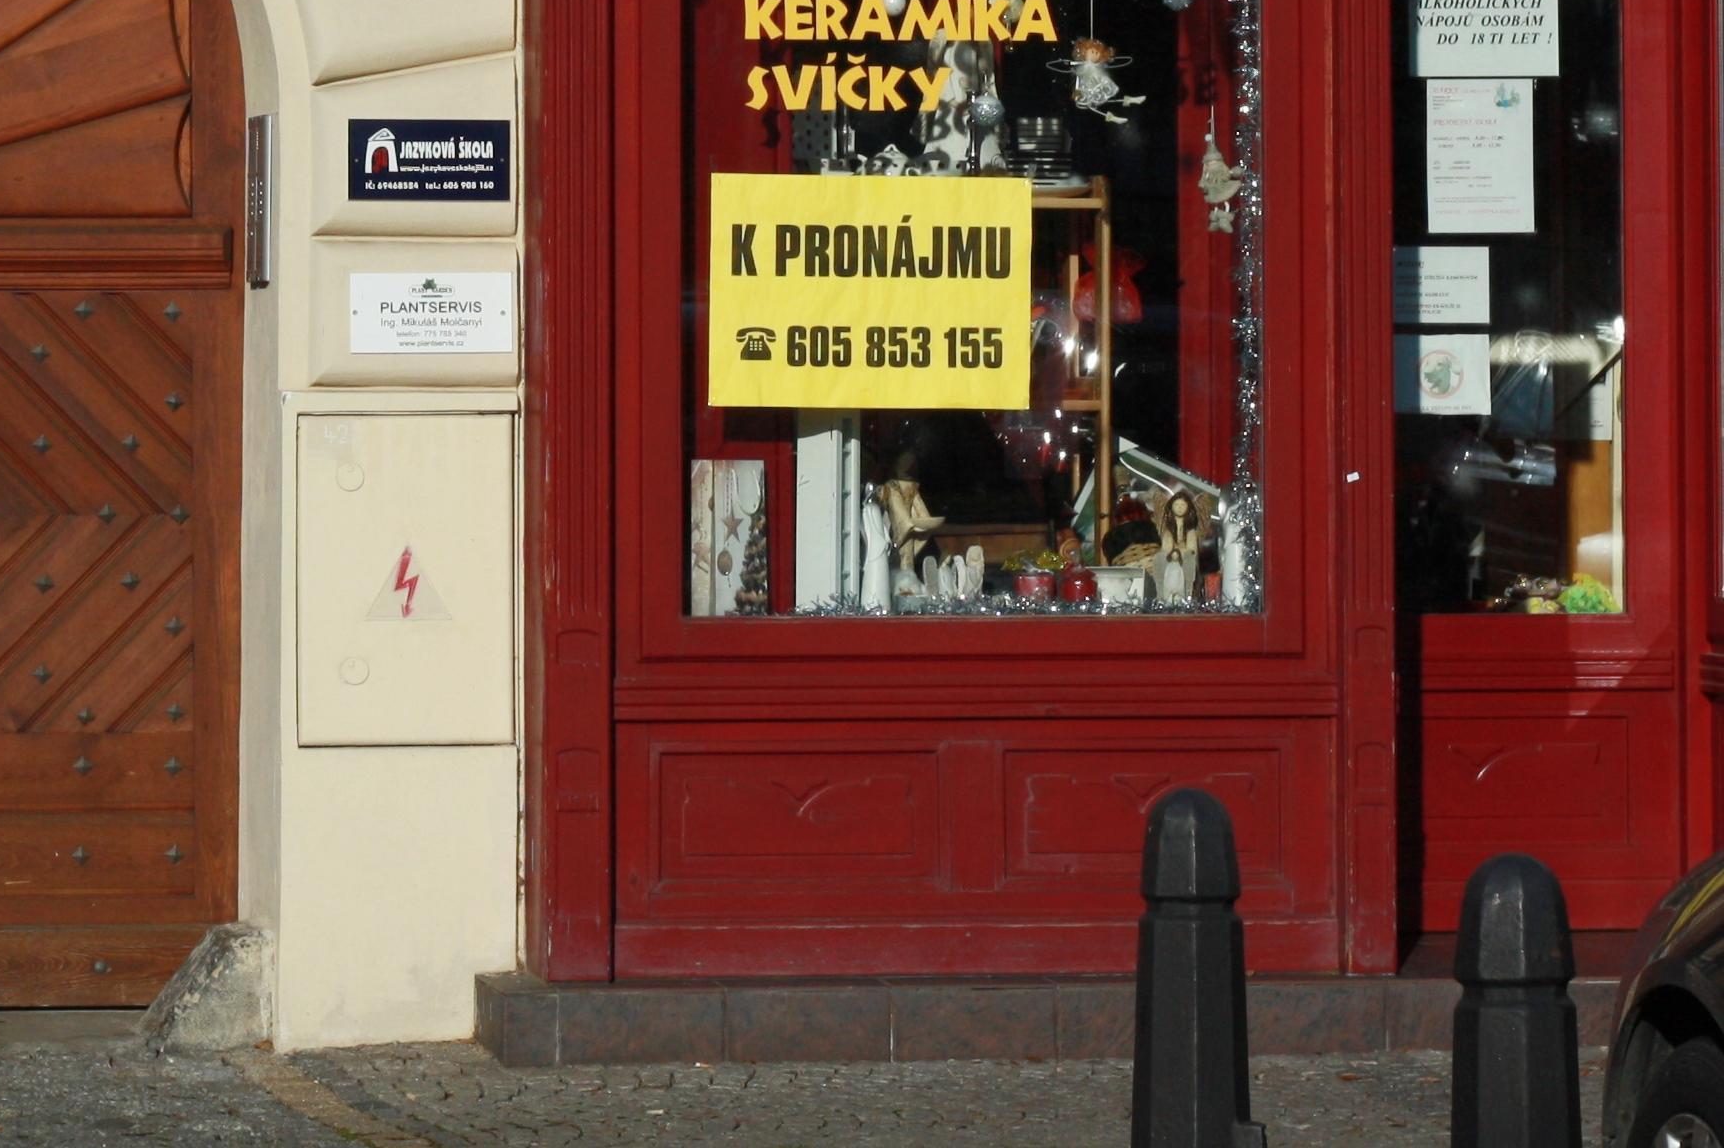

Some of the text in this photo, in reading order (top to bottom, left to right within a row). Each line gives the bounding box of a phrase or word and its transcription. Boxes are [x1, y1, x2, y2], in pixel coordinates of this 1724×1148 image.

[1480, 12, 1544, 28] OSOBÁM
[1436, 33, 1459, 45] DO
[1471, 33, 1485, 45] 18
[1489, 33, 1504, 45] TI
[1511, 33, 1540, 45] LET
[744, 52, 953, 112] SVÍČKY
[399, 136, 494, 159] JAZYKOVÁ ŠKOLA
[731, 214, 1012, 279] K PRONÁJMU
[380, 301, 483, 314] PLANTSERVIS
[786, 325, 1003, 369] 605 853 155
